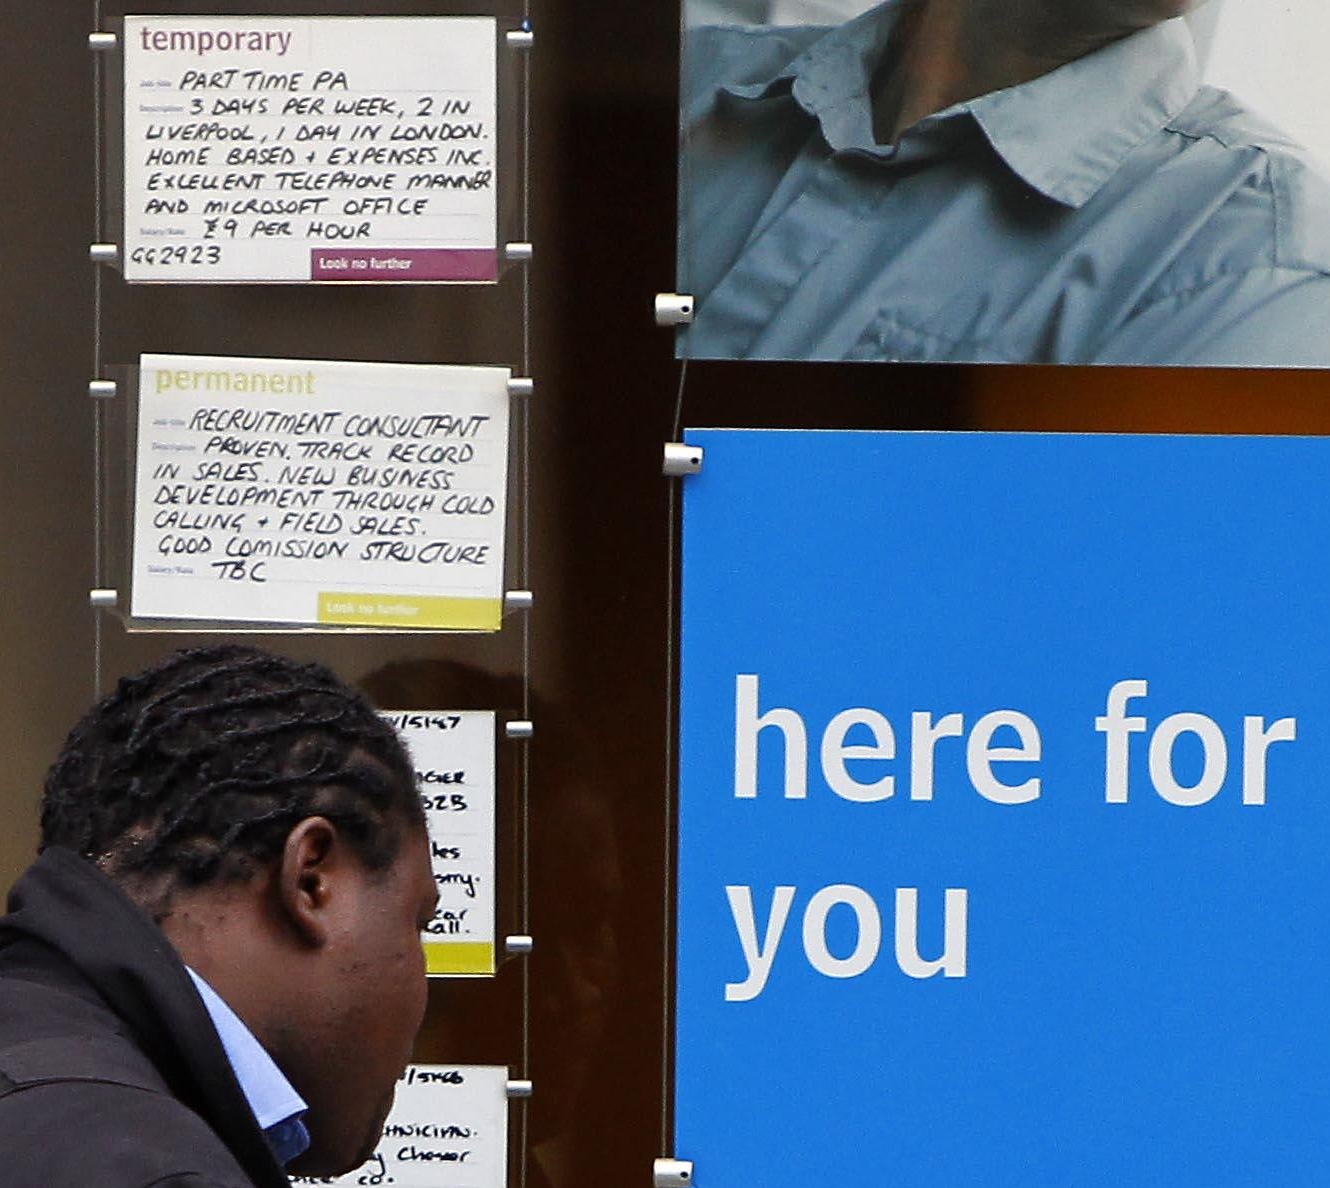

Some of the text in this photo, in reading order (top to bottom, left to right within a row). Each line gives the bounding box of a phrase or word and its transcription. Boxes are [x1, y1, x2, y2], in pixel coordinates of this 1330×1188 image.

[141, 27, 291, 56] temporary
[180, 70, 348, 92] PART TIME PA
[191, 97, 470, 119] 3 DAYS PER WEEK, 2 IN
[251, 221, 291, 237] PER
[307, 222, 370, 239] HOUR
[320, 258, 412, 269] Look no further
[156, 370, 315, 394] permanent
[189, 409, 490, 438] RECRUITMENT CONSULTANT
[212, 560, 265, 582] TBC
[735, 675, 1296, 806] here for
[725, 884, 967, 1001] you
